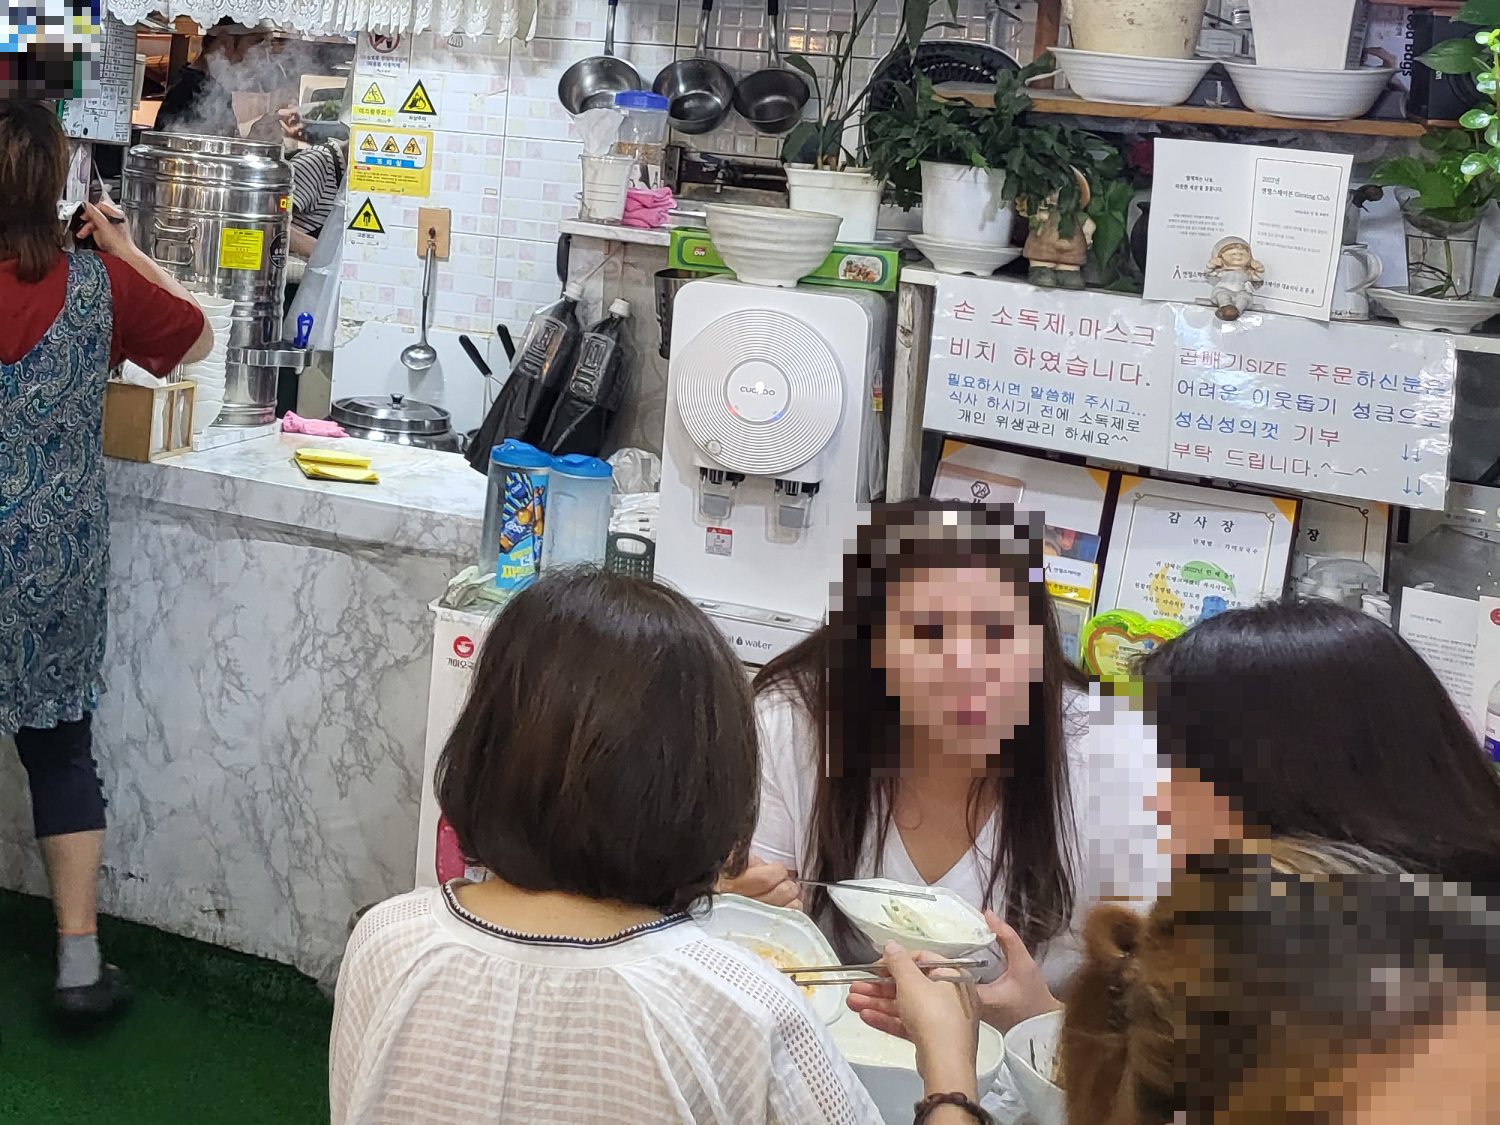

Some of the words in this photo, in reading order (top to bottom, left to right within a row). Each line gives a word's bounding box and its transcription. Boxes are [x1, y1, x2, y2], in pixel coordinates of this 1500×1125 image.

[954, 300, 975, 321] 손
[950, 337, 996, 363] 비치
[1013, 346, 1151, 387] 하였습니다.
[947, 373, 1021, 396] 필요하시면
[1031, 385, 1075, 405] 말씀해
[1177, 379, 1239, 401] 어려운
[1252, 388, 1337, 415] 이웃돕기
[949, 390, 977, 406] 식사
[987, 397, 1030, 415] 하시기
[1040, 404, 1069, 421] 전에
[1078, 412, 1141, 433] 소독제로
[958, 409, 986, 425] 개인
[995, 414, 1055, 436] 위생관리
[1174, 410, 1279, 441] 성심성의껏
[1294, 424, 1340, 446] 기부
[1172, 442, 1212, 463] 부탁
[1168, 512, 1234, 533] 감사장
[745, 639, 773, 650] water
